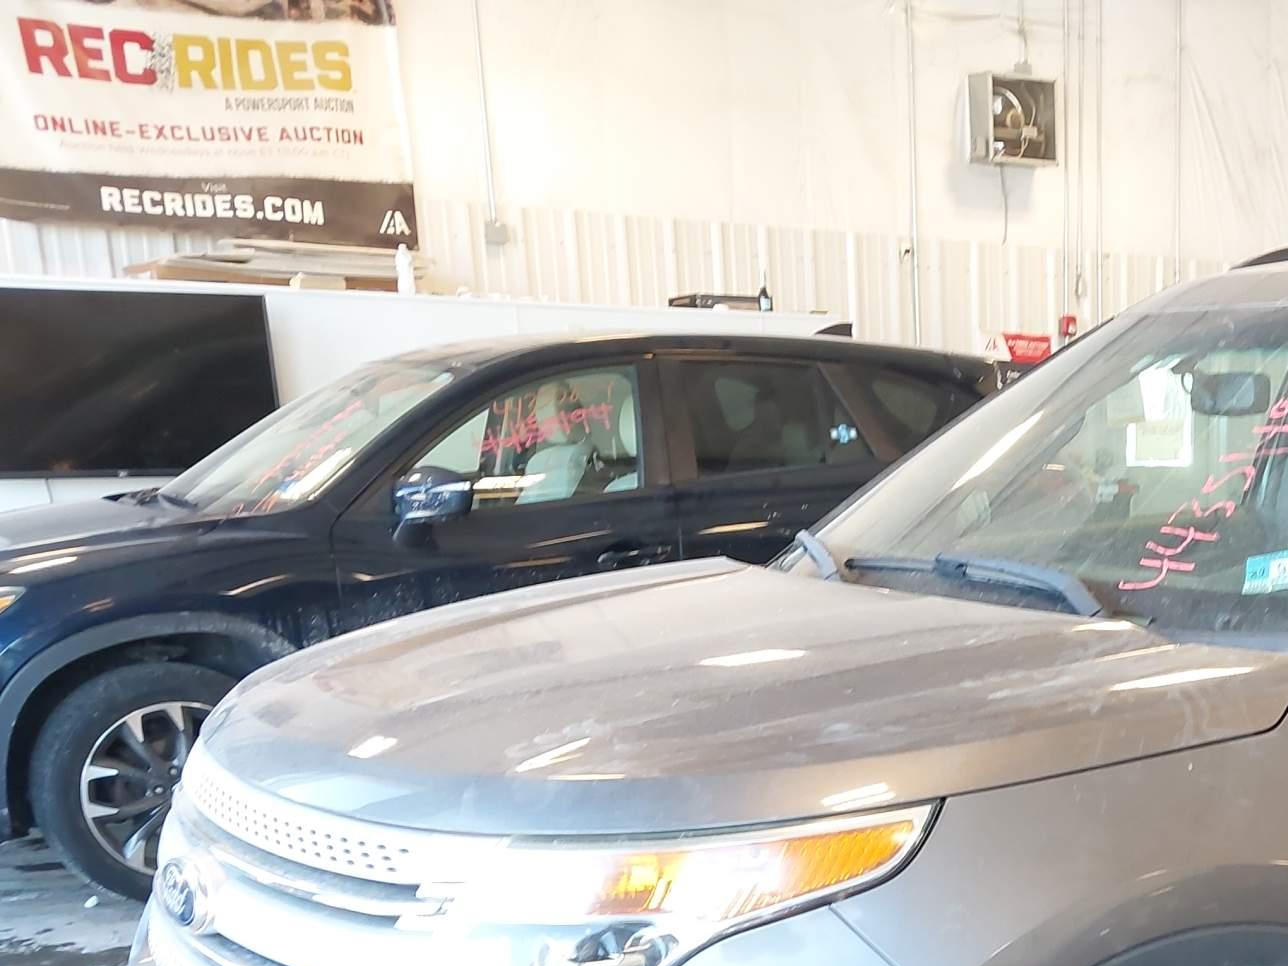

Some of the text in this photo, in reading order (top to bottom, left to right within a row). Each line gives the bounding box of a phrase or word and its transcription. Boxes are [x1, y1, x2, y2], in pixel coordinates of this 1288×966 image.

[17, 16, 353, 92] REC RIDES
[225, 97, 355, 113] A POWERSPORT AUCTION
[33, 113, 364, 145] ONLINE-EXCLUSIVE AUCTION
[201, 181, 228, 193] Visit
[100, 186, 325, 226] RECRIDES.COM
